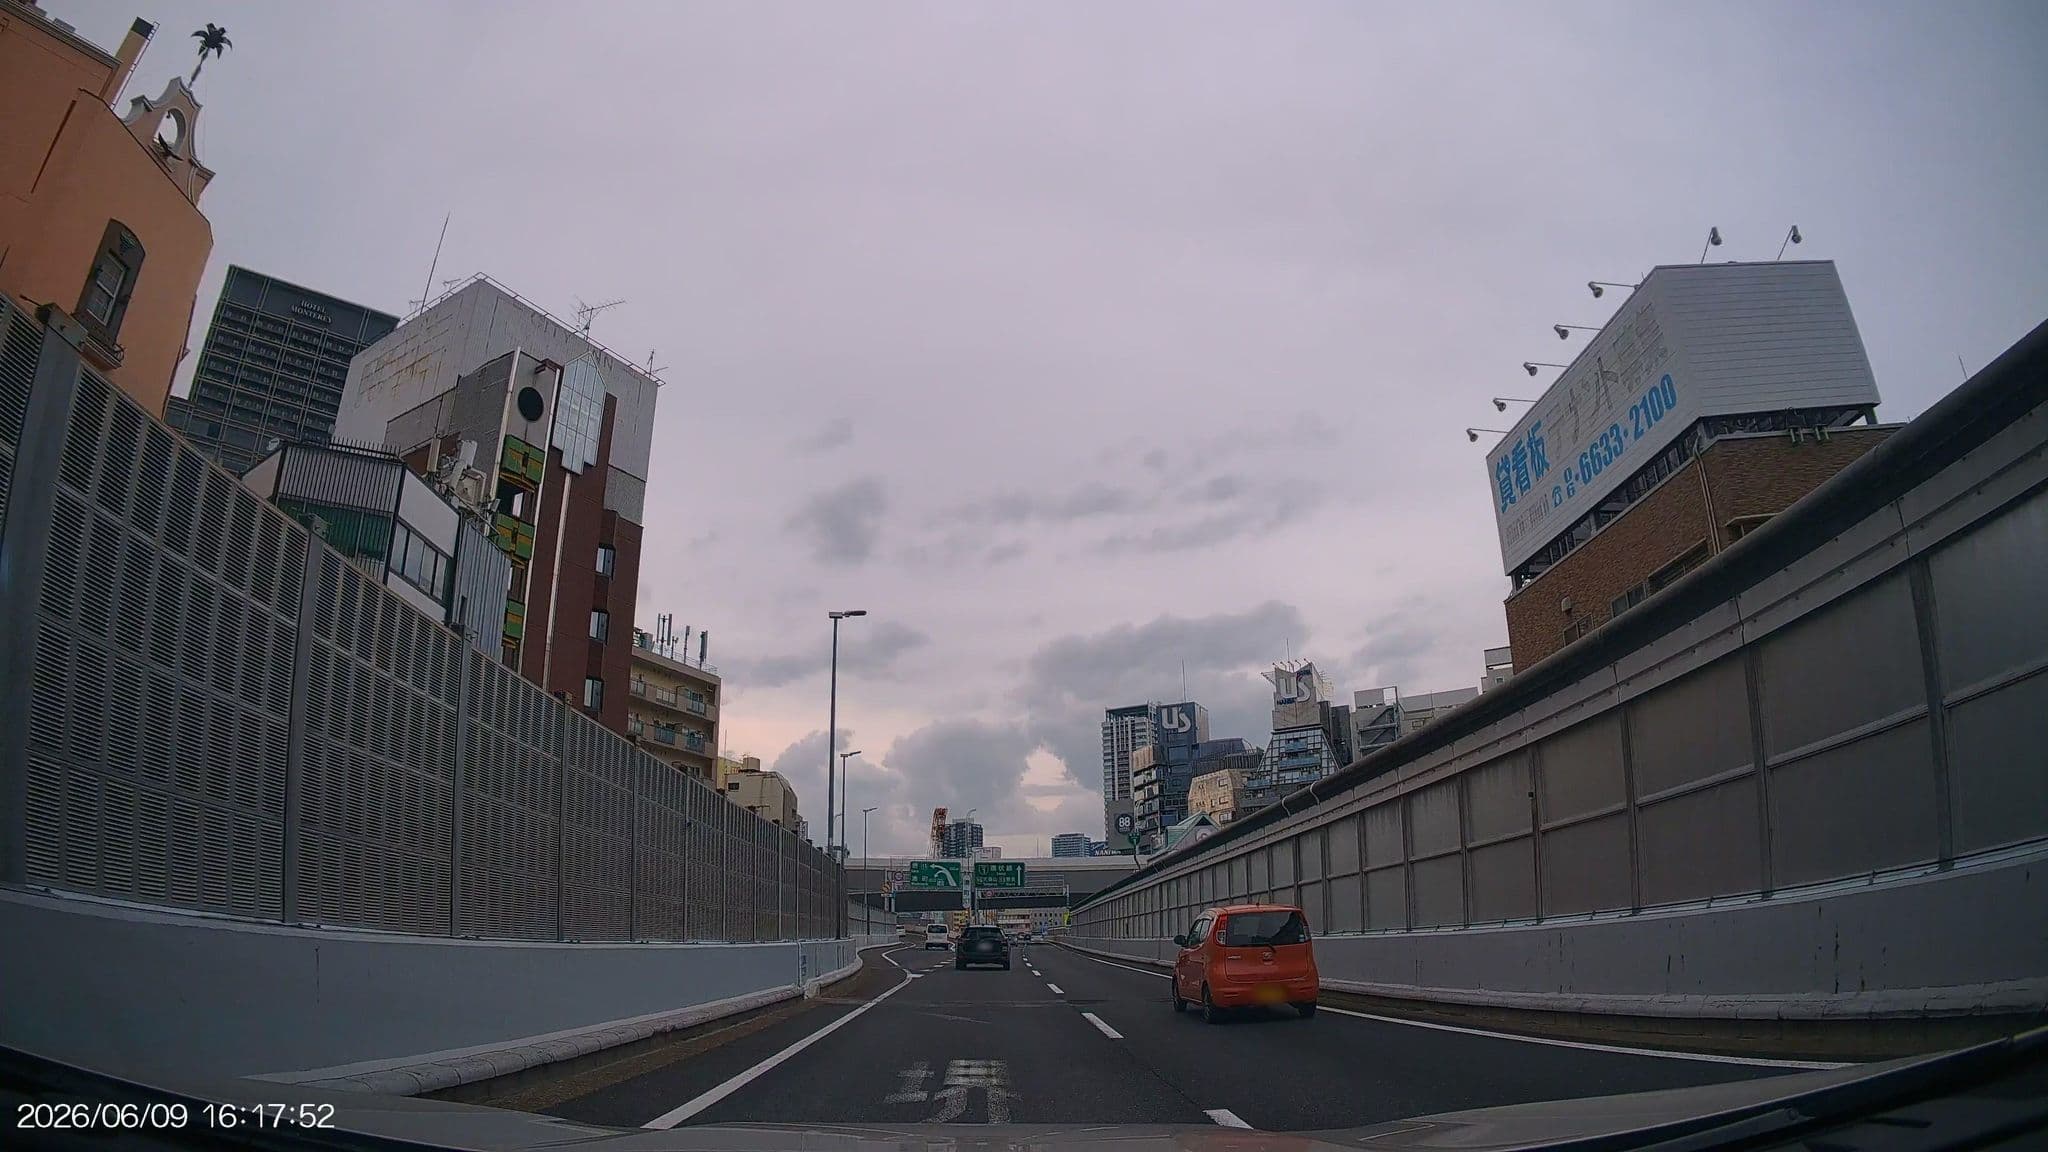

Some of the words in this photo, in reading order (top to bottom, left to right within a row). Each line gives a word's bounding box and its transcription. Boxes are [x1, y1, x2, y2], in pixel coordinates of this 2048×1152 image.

[290, 304, 333, 324] MONTEREY
[299, 298, 327, 315] HOTEL
[1494, 419, 1551, 516] 貸看板
[1118, 816, 1131, 828] 88
